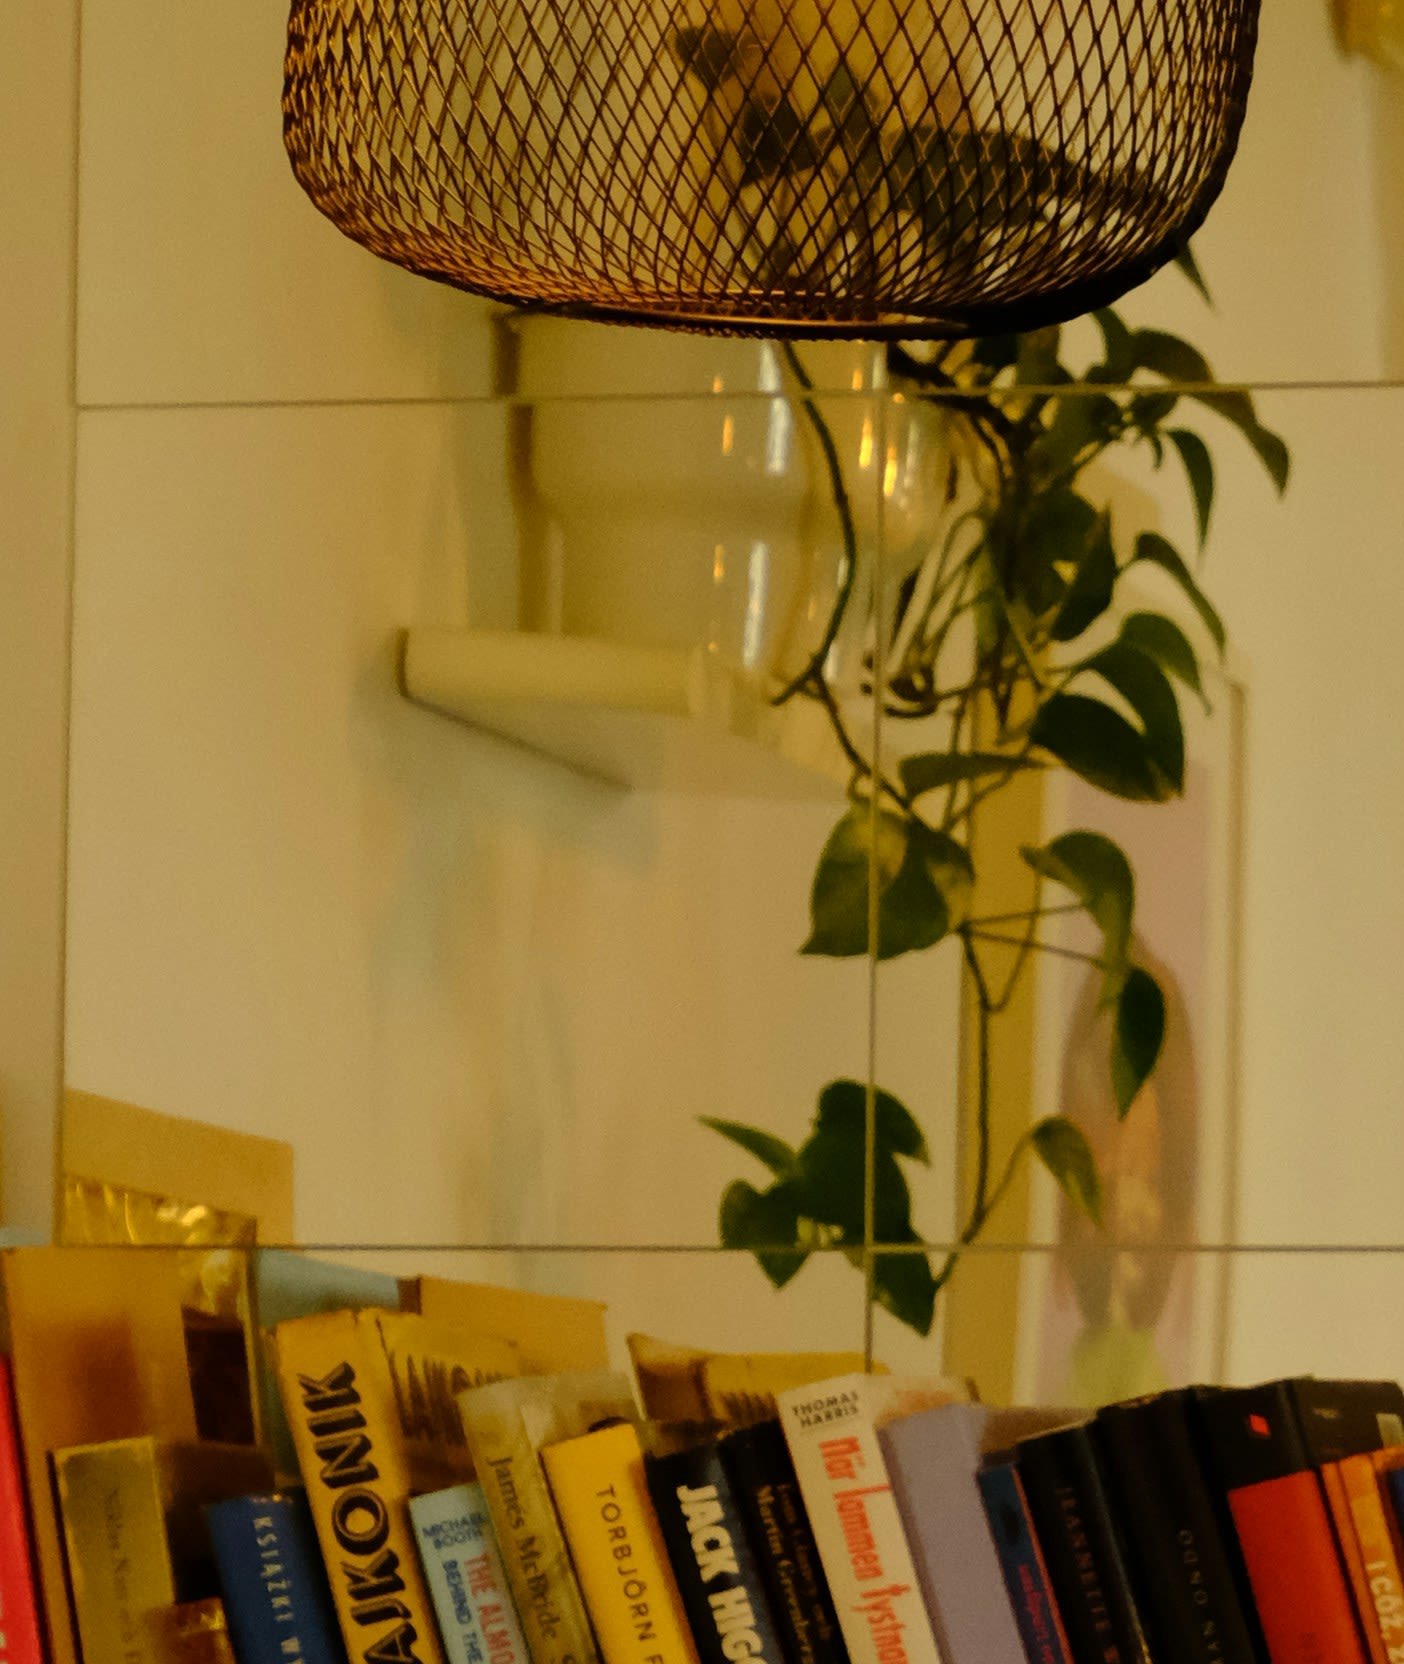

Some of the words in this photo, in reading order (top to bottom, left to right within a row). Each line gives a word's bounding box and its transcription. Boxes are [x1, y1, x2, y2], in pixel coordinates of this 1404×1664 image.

[791, 1390, 859, 1416] THOMAS
[800, 1405, 859, 1428] HARRIS
[816, 1431, 869, 1485] När
[421, 1512, 484, 1539] MICHAEL
[433, 1528, 483, 1550] BOOTH
[486, 1451, 530, 1530] James
[515, 1534, 566, 1641] McBride
[673, 1476, 741, 1584] JACK
[752, 1484, 789, 1555] Martin
[251, 1513, 293, 1622] KSIĄŻKI
[463, 1552, 497, 1598] THE
[592, 1482, 661, 1644] TORBJÖRN
[1365, 1557, 1390, 1573] I
[441, 1558, 473, 1626] BEHIND
[461, 1631, 483, 1664] THE
